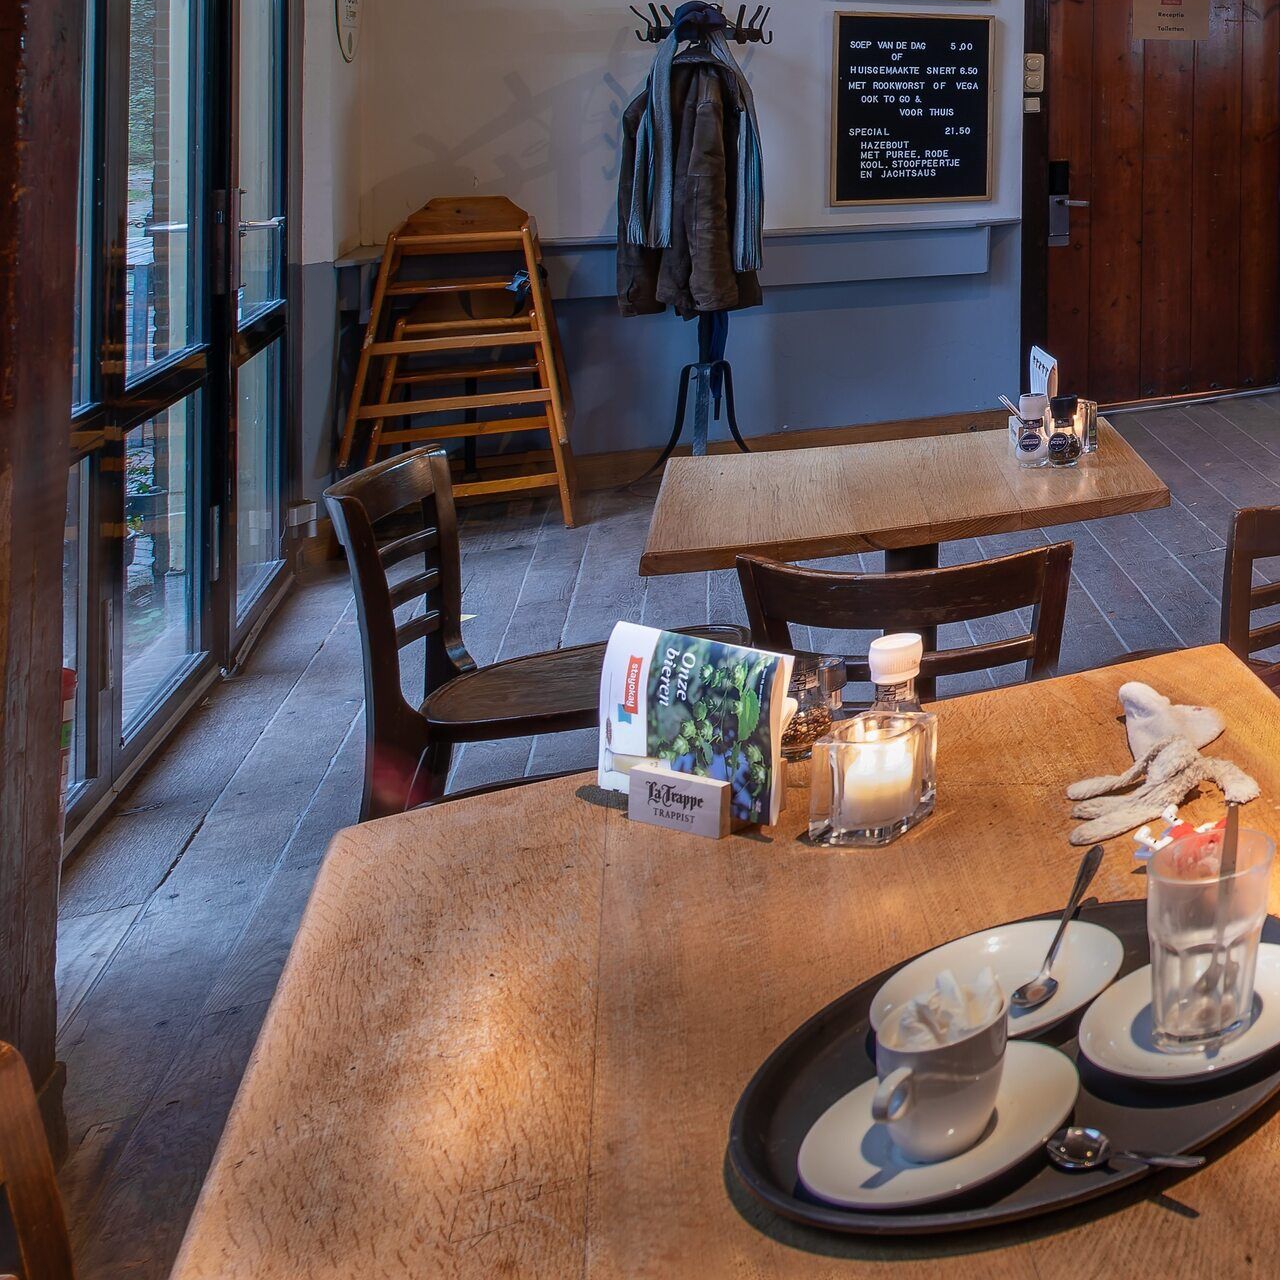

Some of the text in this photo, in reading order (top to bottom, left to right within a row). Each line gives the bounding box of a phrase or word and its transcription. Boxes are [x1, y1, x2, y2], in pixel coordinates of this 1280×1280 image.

[850, 40, 872, 49] SOEP
[877, 41, 894, 49] VAN
[895, 41, 908, 50] DE
[910, 41, 926, 50] DAG
[891, 53, 904, 61] OF
[849, 66, 978, 75] HUISGEMAAKTE SNERT 6.50
[848, 81, 979, 90] MET ROOKWORST OF VEGA
[860, 95, 922, 103] OOK TO GO &
[899, 108, 955, 116] VOOR THUIS
[848, 127, 971, 136] SPECIAL 21.50
[860, 140, 910, 150] HAZEBOUT
[860, 150, 880, 160] MET
[924, 149, 949, 158] RODE
[891, 158, 961, 168] STOOFPEERTJE
[860, 169, 937, 179] EN JACHTSAUS
[659, 647, 680, 707] bieren
[677, 651, 696, 702] Onze
[624, 663, 639, 708] stayokay
[645, 780, 704, 812] La Trappe
[652, 807, 696, 824] TRAPPIST
